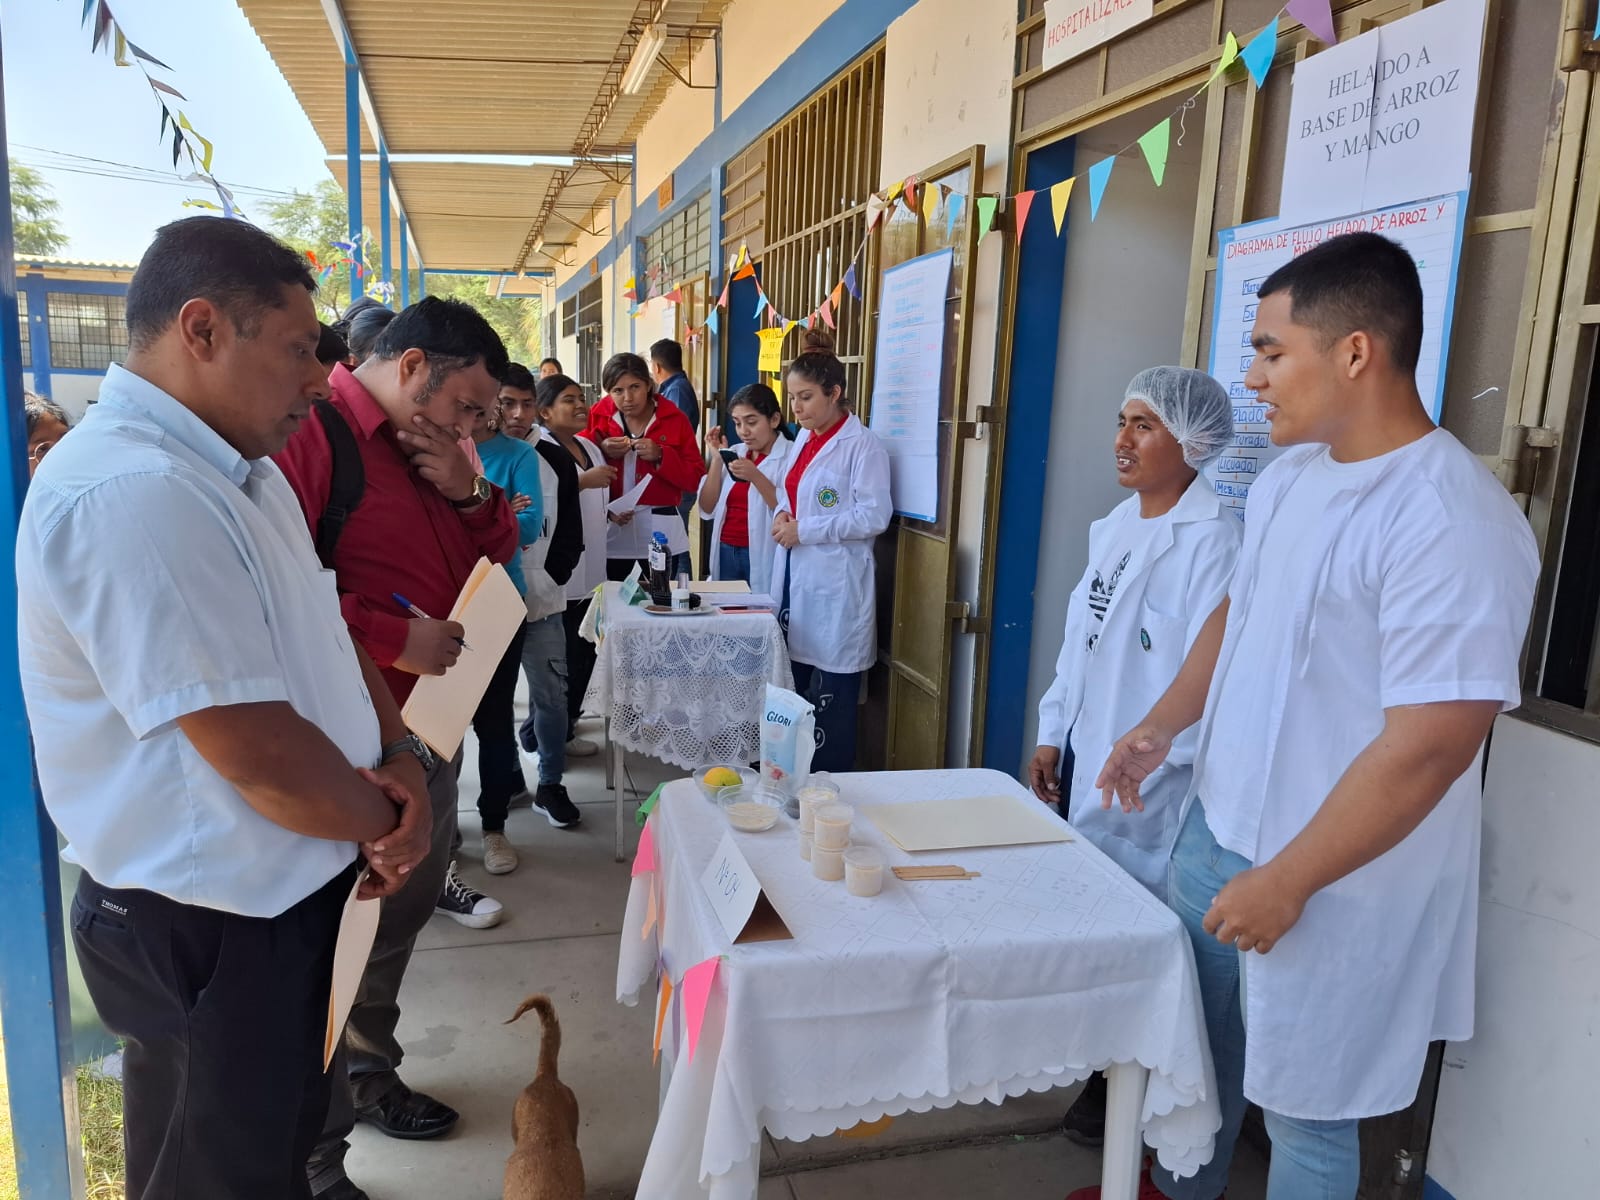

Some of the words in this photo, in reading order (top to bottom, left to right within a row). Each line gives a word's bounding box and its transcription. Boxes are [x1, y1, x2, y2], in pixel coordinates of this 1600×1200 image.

[1328, 52, 1410, 99] HELADO
[1416, 45, 1431, 68] A
[1301, 107, 1347, 139] BASE
[1352, 96, 1380, 123] DE
[1384, 69, 1460, 113] ARROZ
[1325, 143, 1337, 162] Y
[1342, 118, 1420, 159] MANGO
[1227, 238, 1274, 259] DIAGRAMA
[1276, 233, 1288, 249] DE
[1292, 228, 1322, 248] FLUJO
[1371, 214, 1386, 232] DE
[1388, 208, 1427, 229] ARROZ
